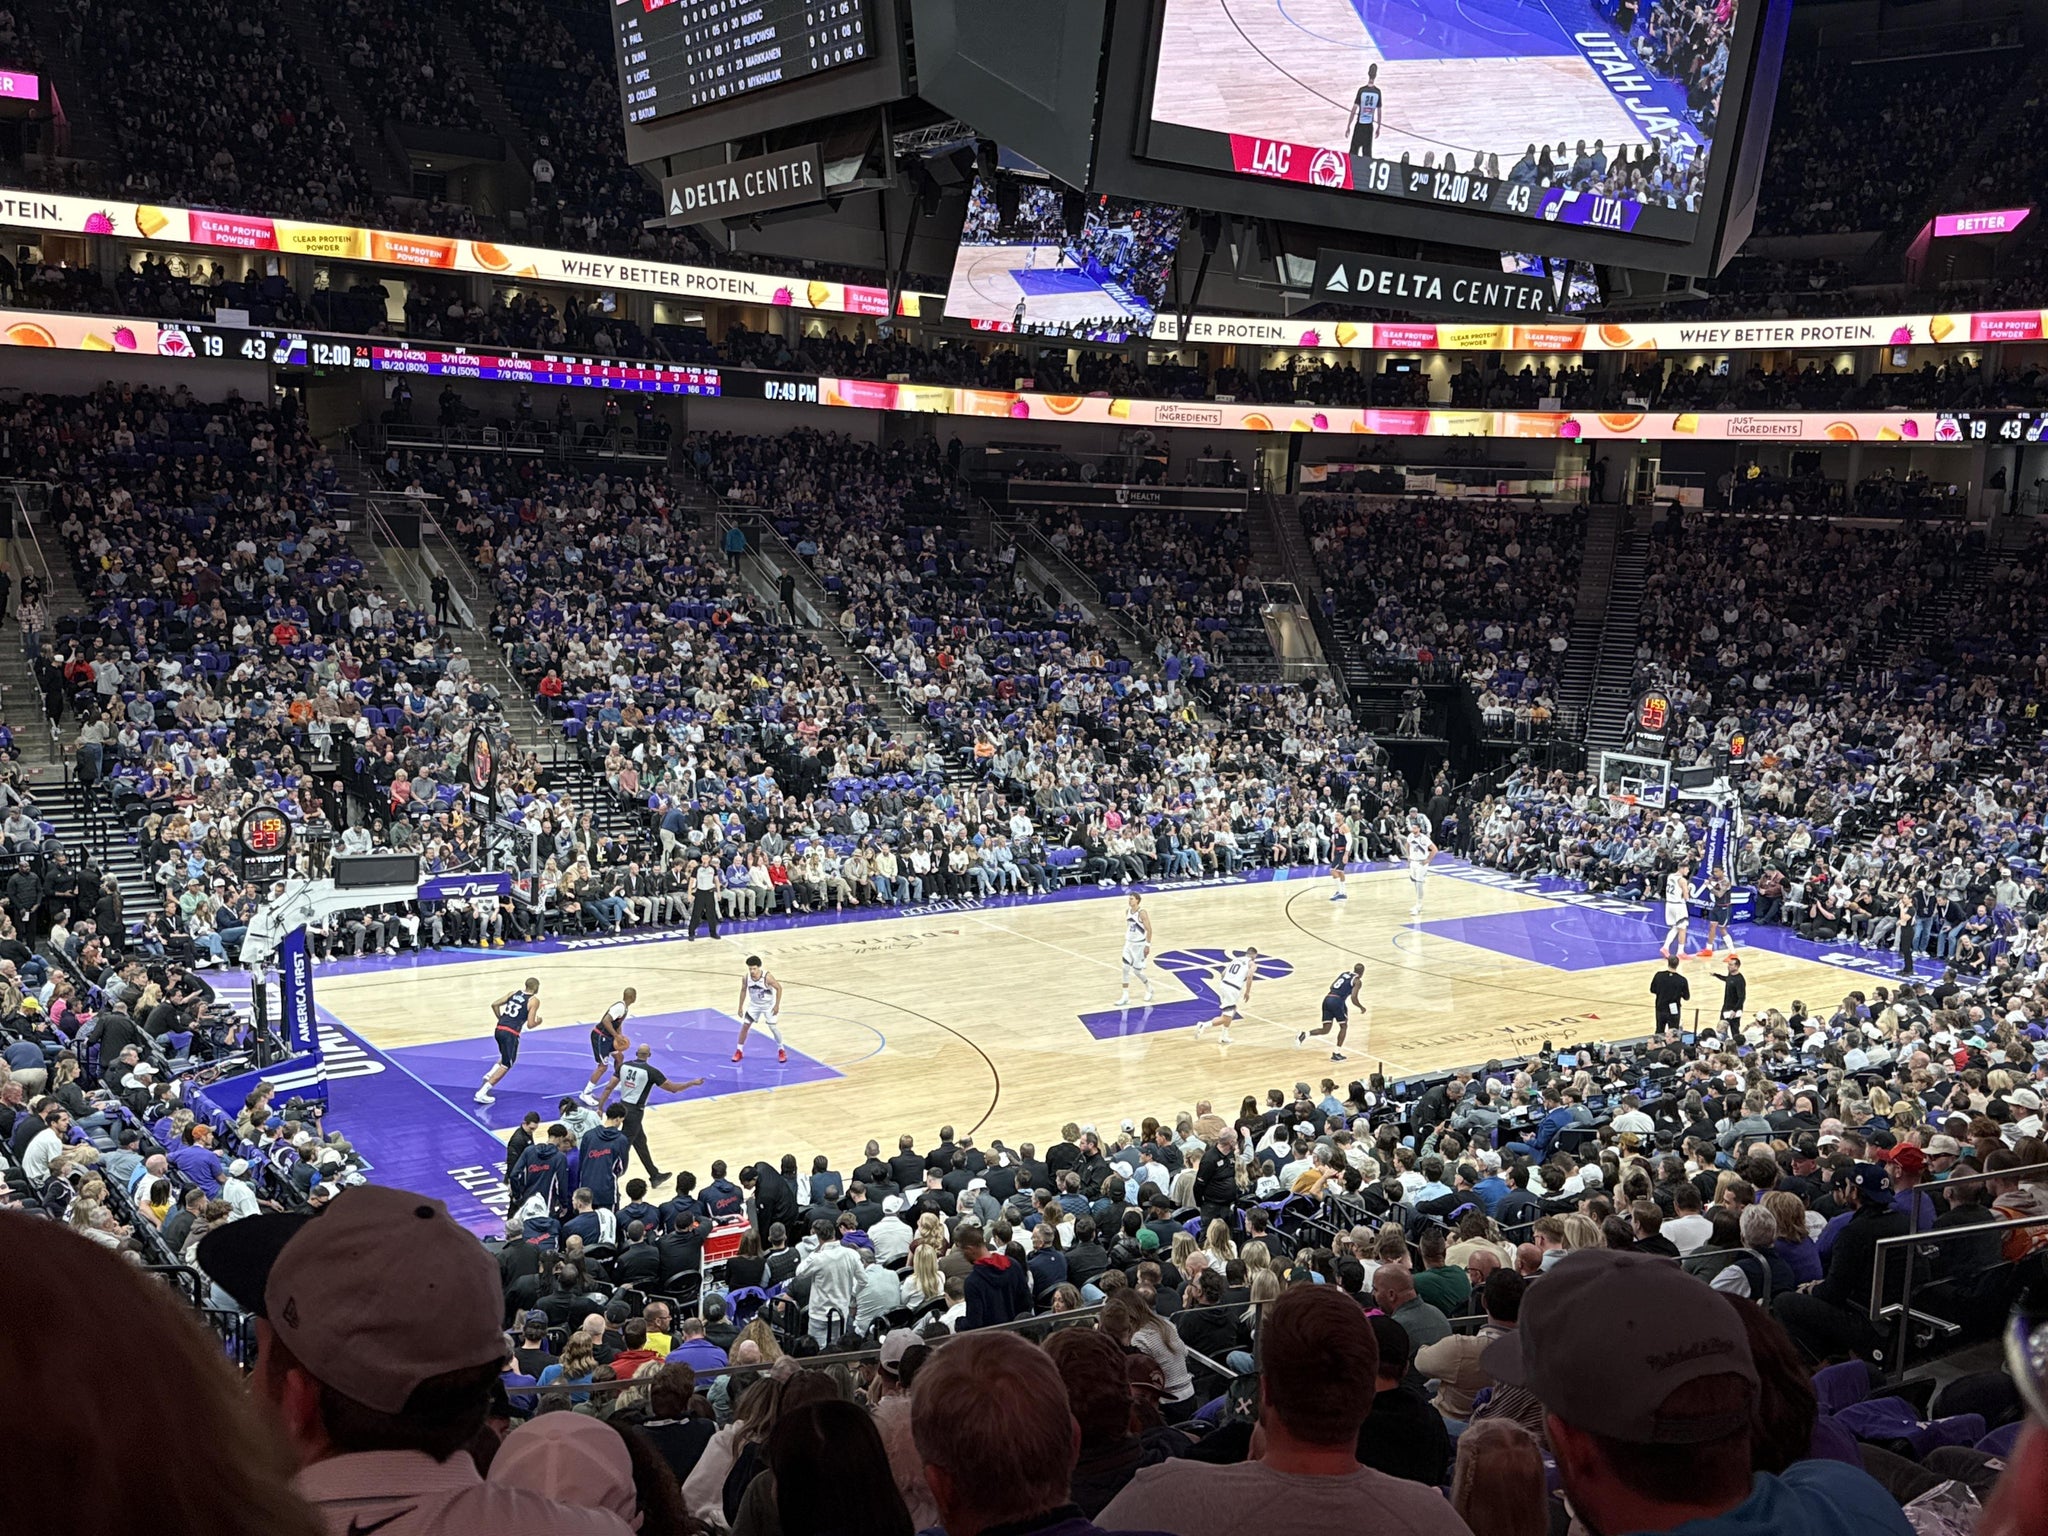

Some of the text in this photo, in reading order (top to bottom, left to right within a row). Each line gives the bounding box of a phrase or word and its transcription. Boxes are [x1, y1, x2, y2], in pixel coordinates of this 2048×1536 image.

[1574, 32, 1652, 92] UTAH
[634, 68, 650, 83] LOPEZ
[636, 86, 657, 102] COLLINS
[638, 106, 656, 120] BATUM
[1252, 139, 1292, 174] LAC
[684, 160, 813, 210] DELTA CENTER
[1369, 161, 1391, 191] 19
[1433, 172, 1469, 203] 12:00
[1472, 182, 1488, 202] 24
[1506, 185, 1531, 213] 43
[0, 199, 63, 221] TEIN.
[1592, 197, 1622, 226] UTA
[201, 220, 271, 240] CLEAR PROTEIN
[1957, 216, 2006, 231] BETTER
[216, 233, 256, 246] POWDER
[293, 235, 352, 245] CLEAR PROTEIN
[306, 244, 340, 252] POWDER
[385, 242, 442, 259] CLEAR PROTEIN
[397, 253, 430, 265] POWDER
[561, 259, 758, 296] WHEY BETTER PROTEIN.
[1357, 268, 1543, 312] DELTA CENTER
[978, 319, 992, 330] LAC
[1019, 324, 1028, 334] 19
[1072, 330, 1082, 339] 43
[1218, 324, 1286, 340] PROTEIN.
[1980, 321, 2037, 330] CLEAR PROTEIN
[1106, 332, 1120, 343] UTA
[1382, 331, 1434, 341] CLEAR PROTEIN
[1450, 332, 1498, 342] CLEAR PROTEIN
[1523, 333, 1573, 342] CLEAR PROTEIN
[1679, 325, 1875, 343] WHEY BETTER PROTEIN.
[1991, 330, 2024, 338] POWDER
[202, 335, 223, 357] 19
[241, 339, 266, 359] 43
[356, 346, 368, 357] 24
[1391, 340, 1422, 348] POWDER
[312, 343, 350, 366] 12:00
[353, 358, 370, 369] 2ND
[384, 349, 403, 359] 8/19
[441, 354, 458, 363] 3/11
[458, 355, 480, 366] (27%)
[498, 359, 514, 368] 0/0
[548, 363, 554, 372] 2
[566, 364, 572, 373] 3
[602, 367, 608, 376] 4
[673, 373, 679, 381] 3
[689, 374, 698, 383] 73
[381, 361, 405, 371] 16/20
[441, 365, 456, 375] 4/8
[457, 367, 480, 377] (50%)
[497, 369, 511, 379] 7/9
[566, 375, 572, 384] 9
[583, 376, 591, 385] 10
[601, 378, 610, 387] 12
[620, 379, 626, 388] 7
[655, 382, 661, 391] 3
[673, 384, 680, 392] 17
[706, 386, 715, 395] 73
[764, 380, 817, 403] 07:49 PM
[1159, 412, 1218, 423] INGREDIENTS
[1731, 417, 1754, 425] JUST
[1731, 425, 1798, 434] INGREDIENTS
[1970, 420, 1987, 439] 19
[2000, 420, 2022, 439] 43
[1130, 491, 1161, 501] HEALTH
[1642, 708, 1663, 728] 23
[1731, 745, 1742, 755] 23
[252, 818, 281, 831] 11:59
[253, 831, 276, 848] 23
[256, 855, 286, 864] TISSOT
[1229, 963, 1241, 975] 10
[1333, 978, 1345, 989] 8
[294, 951, 312, 1043] AMERICA FIRST
[503, 1000, 522, 1018] 33
[626, 1069, 637, 1082] 34
